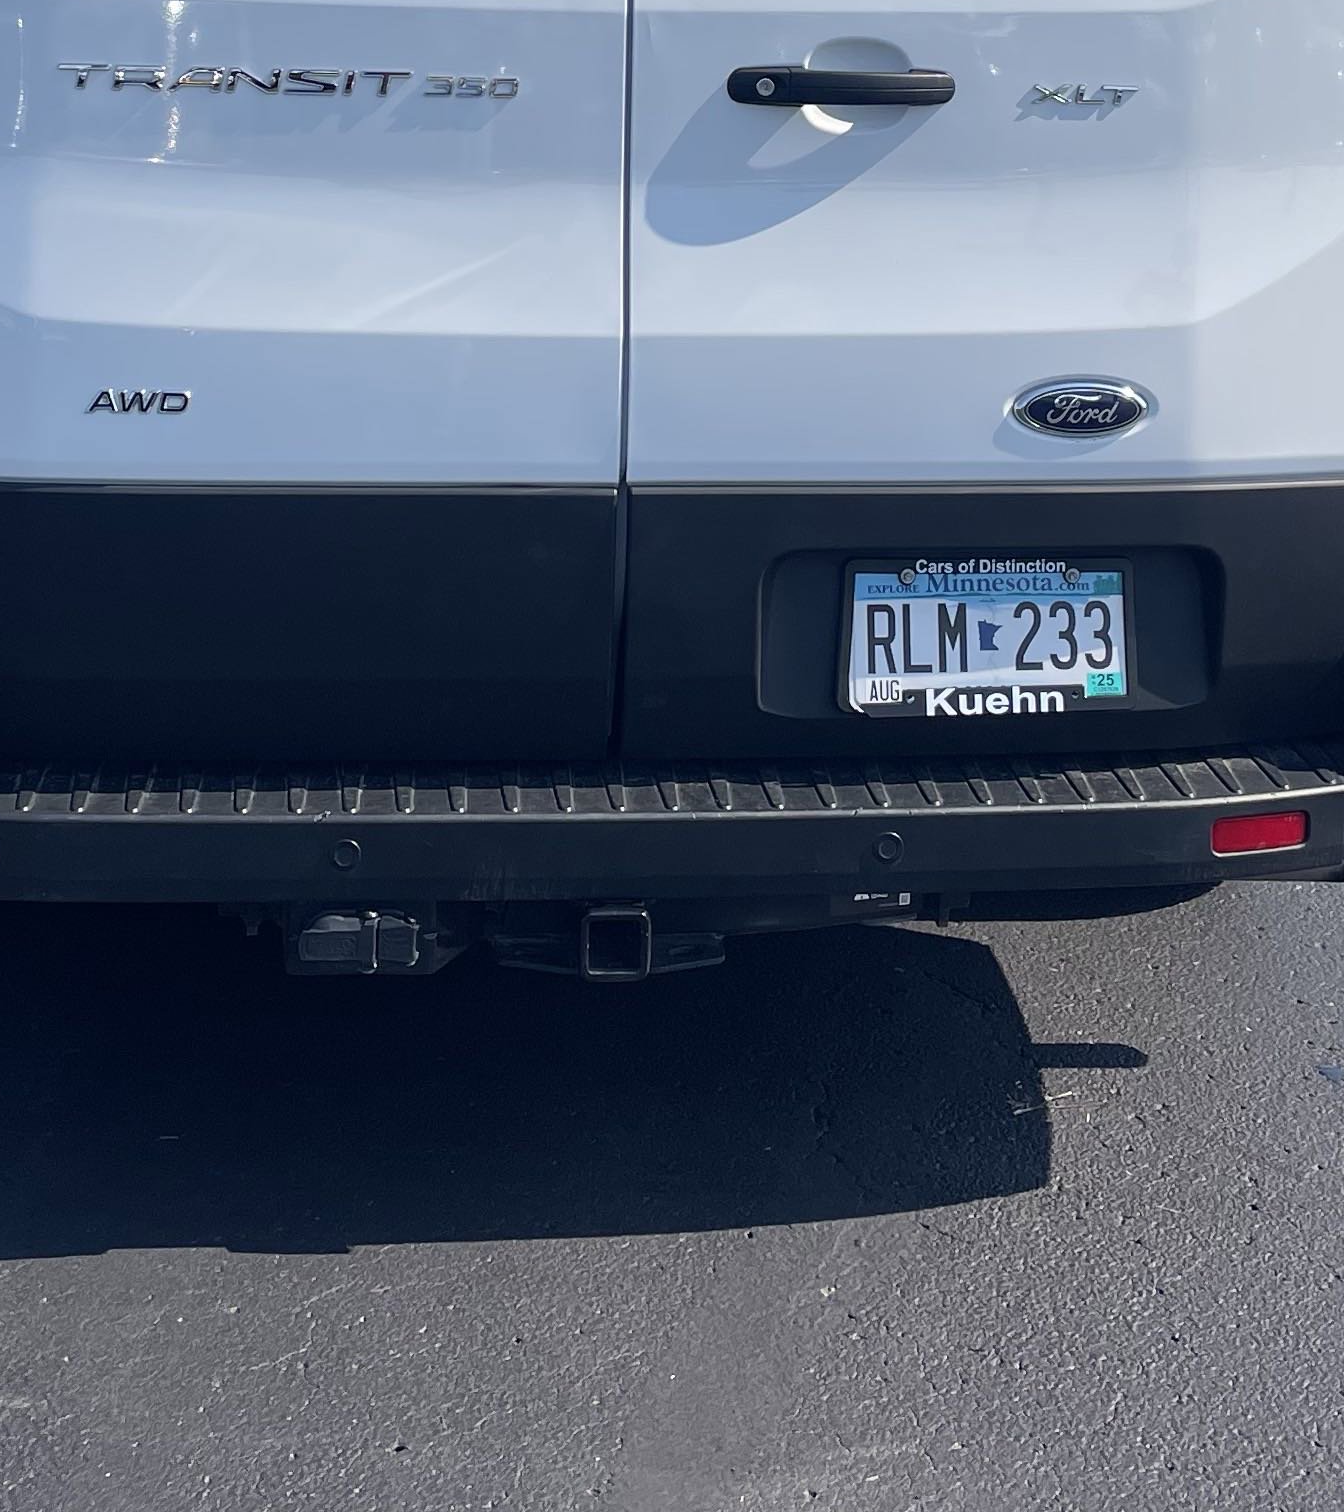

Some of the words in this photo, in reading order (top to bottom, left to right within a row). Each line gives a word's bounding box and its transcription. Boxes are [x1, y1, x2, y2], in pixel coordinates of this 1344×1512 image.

[57, 63, 414, 97] TRANSIT
[423, 75, 519, 98] 350
[1031, 83, 1139, 106] XLT
[85, 388, 192, 414] AWD
[1046, 393, 1120, 424] Ford
[915, 559, 954, 574] Cars
[958, 559, 976, 574] of
[979, 559, 1067, 573] Distinction
[867, 584, 920, 594] EXPLORE
[866, 603, 968, 674] RLM
[1013, 600, 1113, 671] 233
[869, 679, 901, 702] AUG
[1096, 673, 1115, 686] 25
[925, 686, 1065, 716] Kuehn
